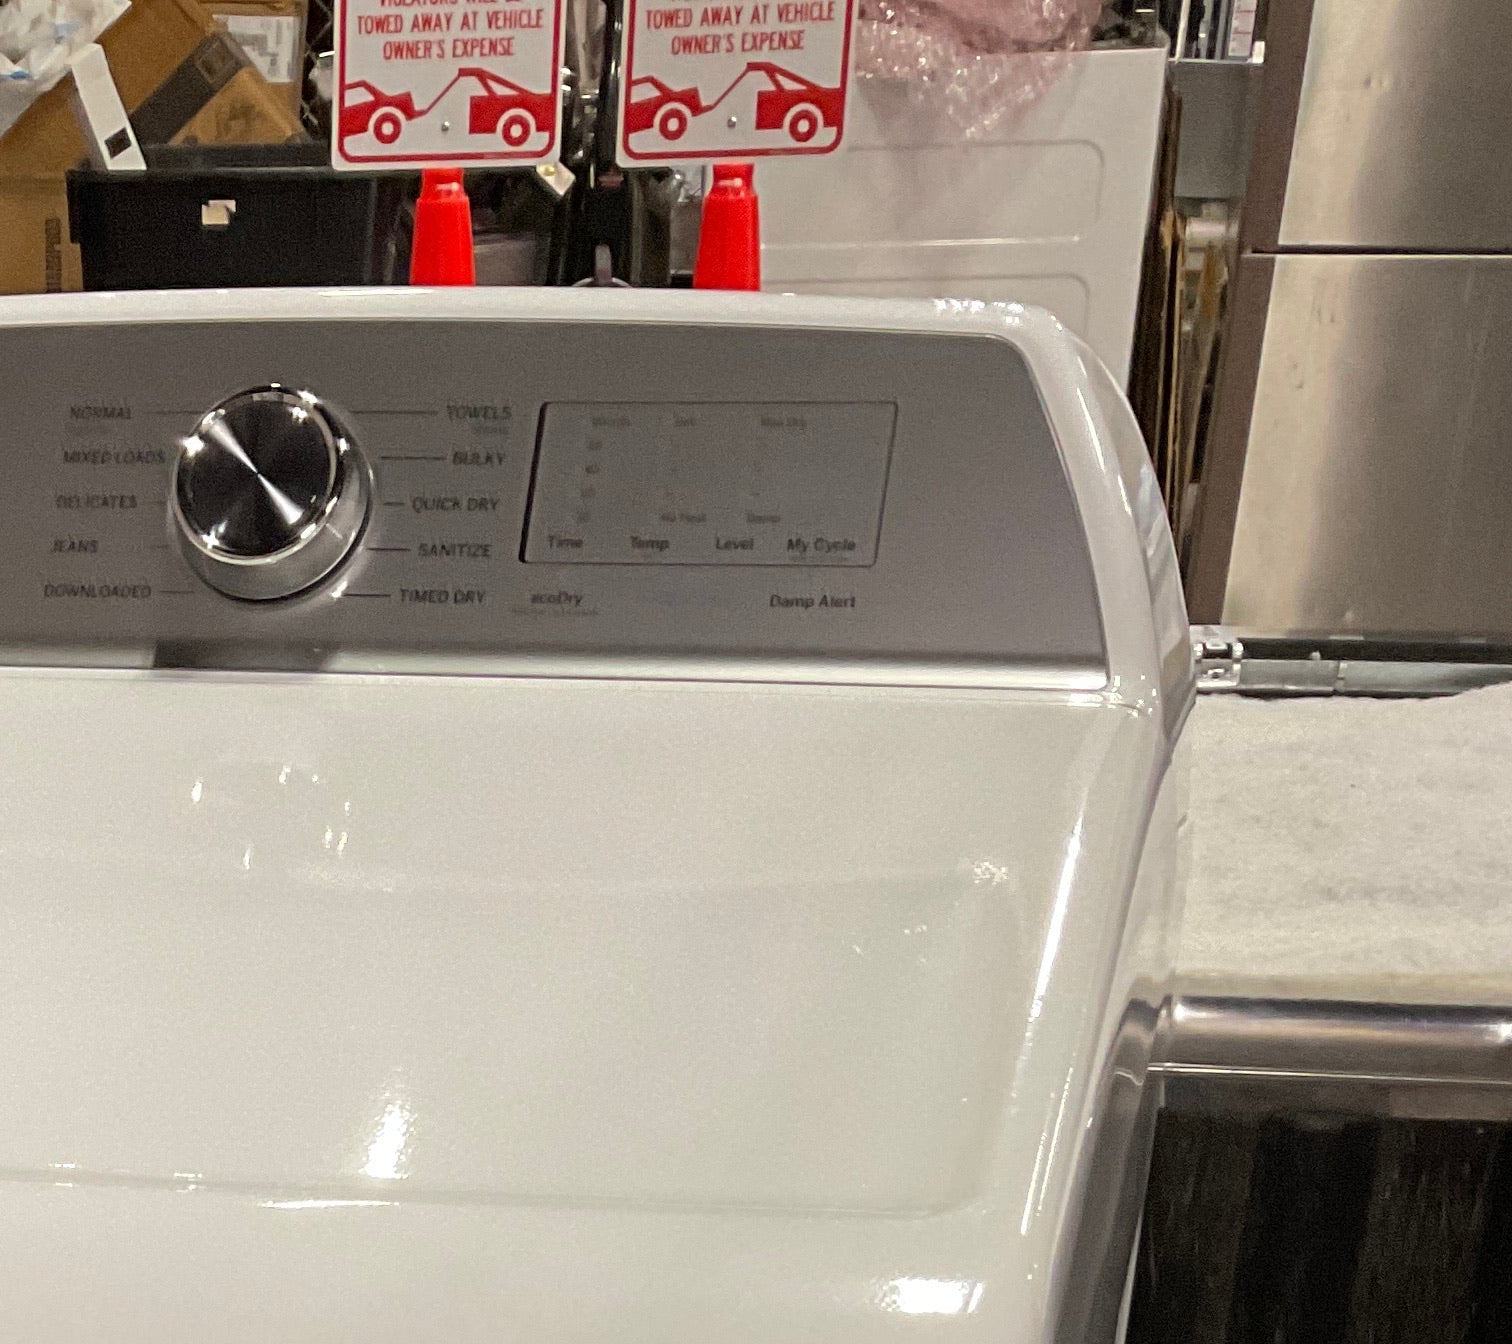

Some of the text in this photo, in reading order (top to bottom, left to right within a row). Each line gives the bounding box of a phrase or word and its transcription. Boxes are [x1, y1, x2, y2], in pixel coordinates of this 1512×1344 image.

[357, 8, 545, 35] TOWED AWAY AT VEHICLE
[646, 1, 836, 30] TOWED AWAY AT VEHICLE
[383, 36, 515, 61] OWNER'S EXPENSE
[671, 29, 805, 55] OWNER'S EXPENSE
[70, 405, 131, 419] NORMAL
[447, 404, 512, 420] TOWELS
[63, 449, 166, 465] MIXED LOADS
[452, 451, 506, 466] BULKY
[55, 494, 138, 509] DELICATES
[412, 496, 500, 513] QUICK DRY
[52, 539, 99, 553] JEANS
[548, 534, 584, 549] Time
[630, 535, 671, 552] Temp
[715, 536, 755, 551] Level
[787, 537, 857, 553] My Cycle
[418, 543, 492, 558] SANITIZE
[44, 584, 152, 599] DOWNLOADED
[400, 588, 487, 605] TIMED DRY
[769, 594, 856, 610] Damp Alert
